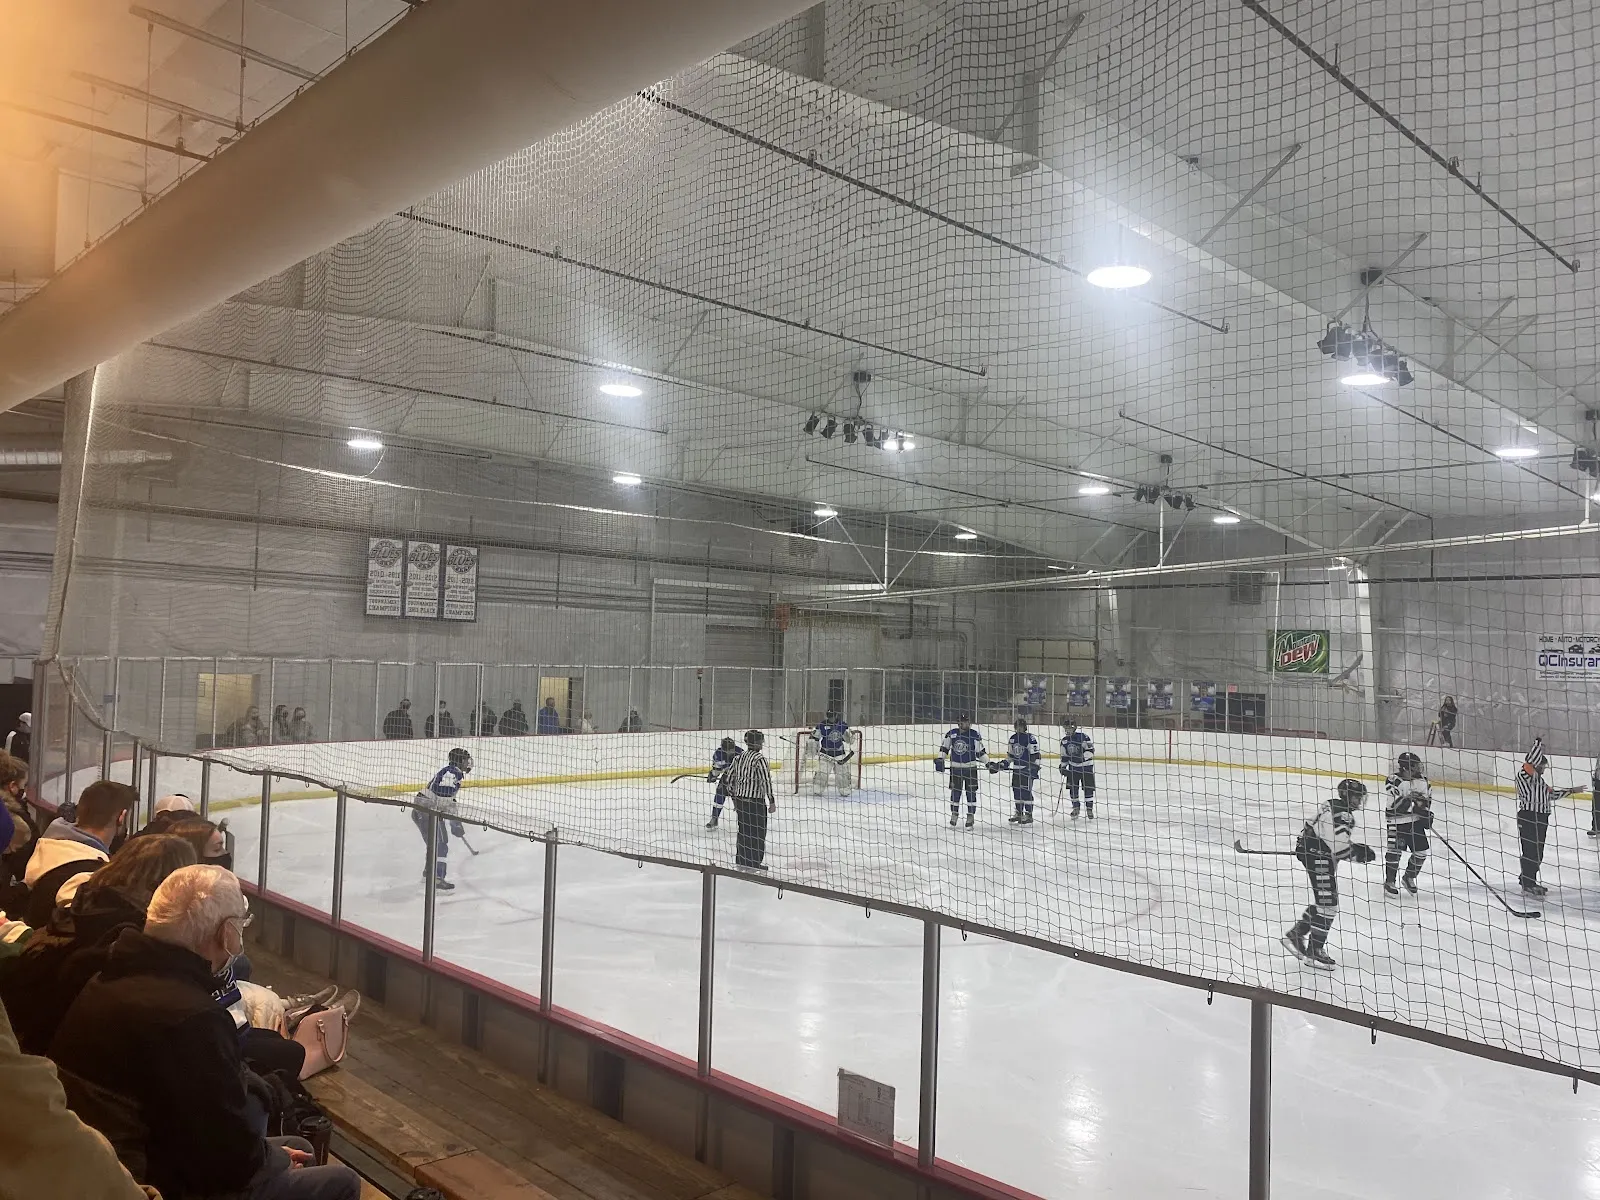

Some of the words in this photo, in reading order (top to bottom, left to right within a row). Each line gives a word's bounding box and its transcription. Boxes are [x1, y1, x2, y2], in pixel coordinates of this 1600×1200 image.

[368, 547, 402, 560] BLUES
[408, 550, 441, 563] BLUES
[446, 554, 476, 566] BLUES
